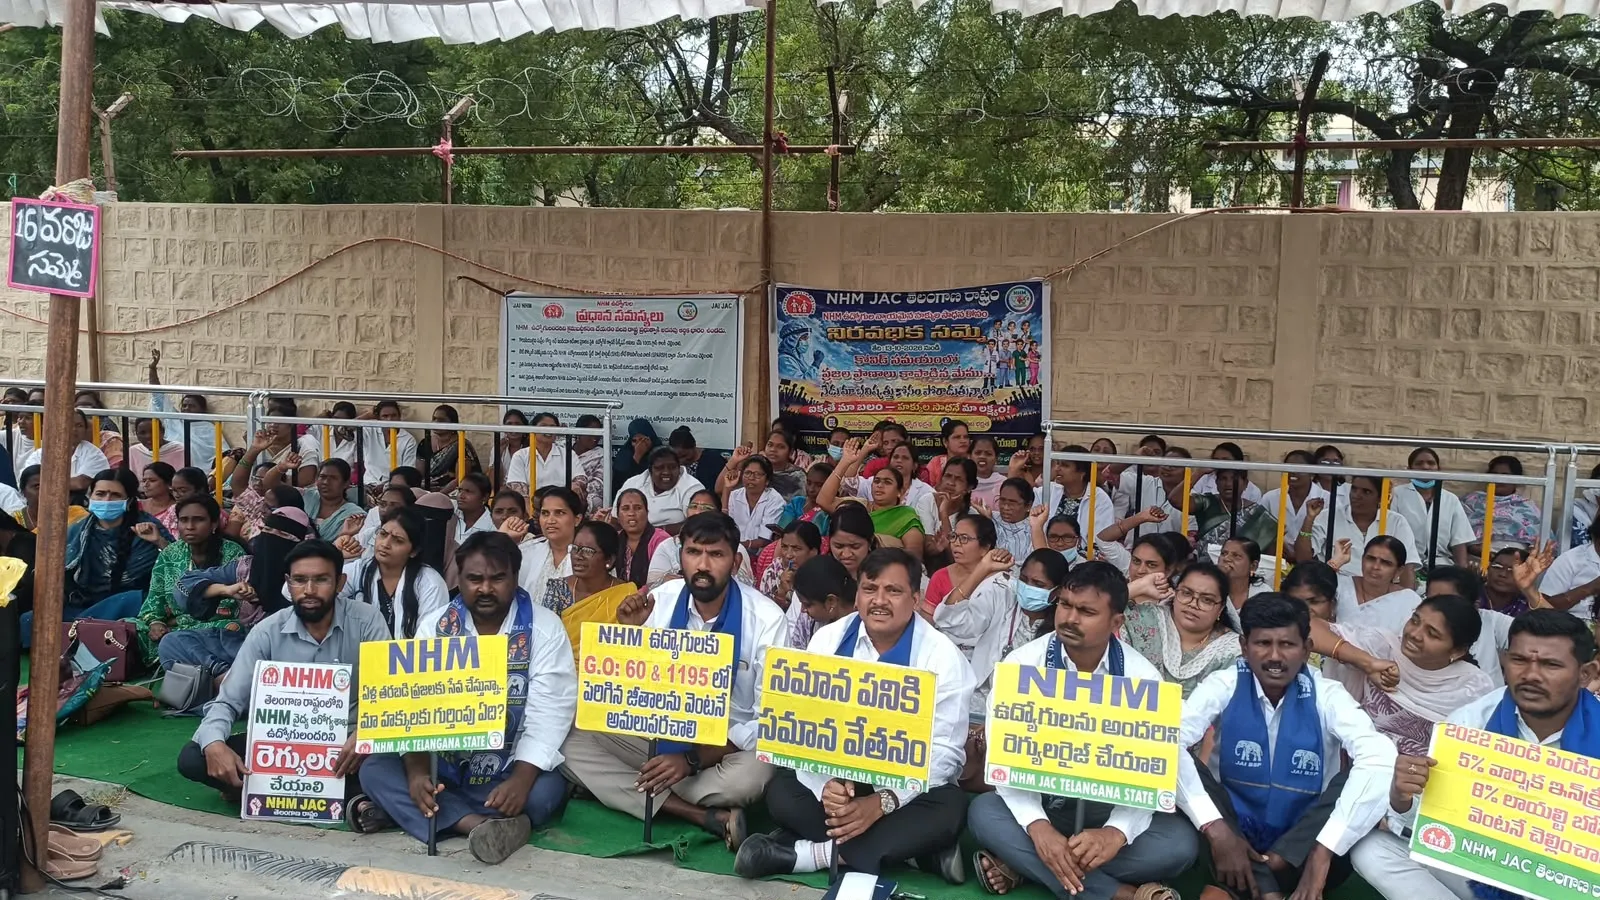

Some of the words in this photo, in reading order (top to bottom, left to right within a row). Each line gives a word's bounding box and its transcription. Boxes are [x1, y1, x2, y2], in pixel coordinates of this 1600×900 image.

[826, 293, 864, 305] NHM
[869, 293, 902, 305] JAC
[906, 292, 962, 305] తెలంగాణ
[964, 288, 1000, 307] రాష్ట్రం
[576, 309, 612, 323] ప్రధాన
[615, 309, 664, 327] సమస్యలు
[822, 312, 841, 320] NHM
[826, 325, 924, 342] నిరవధిక
[930, 324, 987, 344] సమ్మె
[854, 354, 888, 366] కోవిడ్
[890, 354, 959, 365] సమయంలో
[821, 368, 851, 383] ప్రజల
[853, 368, 897, 383] ప్రాణాలు
[899, 368, 948, 382] కాపాడిన
[838, 404, 855, 412] మా
[856, 403, 883, 412] బలం
[897, 403, 931, 414] హక్కుల
[961, 404, 978, 412] మా
[388, 636, 480, 676] NHM
[598, 625, 643, 647] NHM
[649, 629, 720, 659] ఉద్యోగులకు
[282, 666, 334, 690] NHM
[584, 655, 620, 677] G.O:
[625, 659, 647, 680] 60
[651, 664, 661, 682] &
[667, 663, 709, 687] 1195
[712, 664, 732, 690] లో
[770, 658, 852, 703] సమాన
[857, 672, 921, 715] పనికి
[379, 683, 410, 699] తరబడి
[411, 682, 445, 700] ప్రజలకు
[447, 677, 463, 694] సేవ
[583, 681, 624, 705] పెరిగిన
[626, 686, 682, 712] జీతాలను
[685, 692, 727, 718] వెంటనే
[1017, 664, 1160, 712] NHM
[255, 708, 291, 725] NHM
[292, 713, 309, 729] వైద్య
[264, 694, 302, 707] తెలంగాణ
[302, 698, 344, 714] రాష్ట్రంలోని
[360, 711, 378, 730] మా
[380, 709, 431, 733] హక్కులకు
[433, 705, 475, 730] గుర్తింపు
[478, 702, 505, 722] ఏది?
[993, 701, 1097, 733] ఉద్యోగులను
[266, 728, 337, 742] ఉద్యోగులందరిని
[606, 710, 698, 740] అమలుపరచాలి
[758, 706, 838, 753] సమాన
[844, 716, 927, 768] వేతనం
[374, 741, 395, 754] NHM
[395, 739, 411, 752] JAC
[412, 737, 460, 751] TELANGANA
[462, 735, 486, 749] STATE
[1003, 732, 1091, 769] రెగ్యులరైజ్
[1095, 745, 1167, 777] చేయాలి
[1444, 724, 1492, 748] 2022
[1493, 737, 1542, 763] నుండి
[256, 744, 343, 778] రెగ్యులర్
[773, 756, 797, 770] NHM
[798, 760, 815, 775] JAC
[816, 764, 873, 785] TELANGANA
[875, 774, 903, 791] STATE
[1457, 752, 1485, 774] 5%
[1488, 763, 1546, 793] వార్షిక
[269, 776, 324, 793] చేయాలి
[1010, 770, 1036, 786] NHM
[1038, 774, 1057, 790] JAC
[1059, 777, 1121, 801] TELANGANA
[1124, 787, 1154, 806] STATE
[1471, 782, 1499, 805] 8%
[266, 796, 298, 810] NHM
[299, 798, 327, 811] JAC
[1468, 806, 1527, 838] వెంటనే
[1460, 838, 1497, 862] NHM
[1499, 853, 1532, 873] JAC
[1534, 863, 1590, 894] తెలంగాణ
